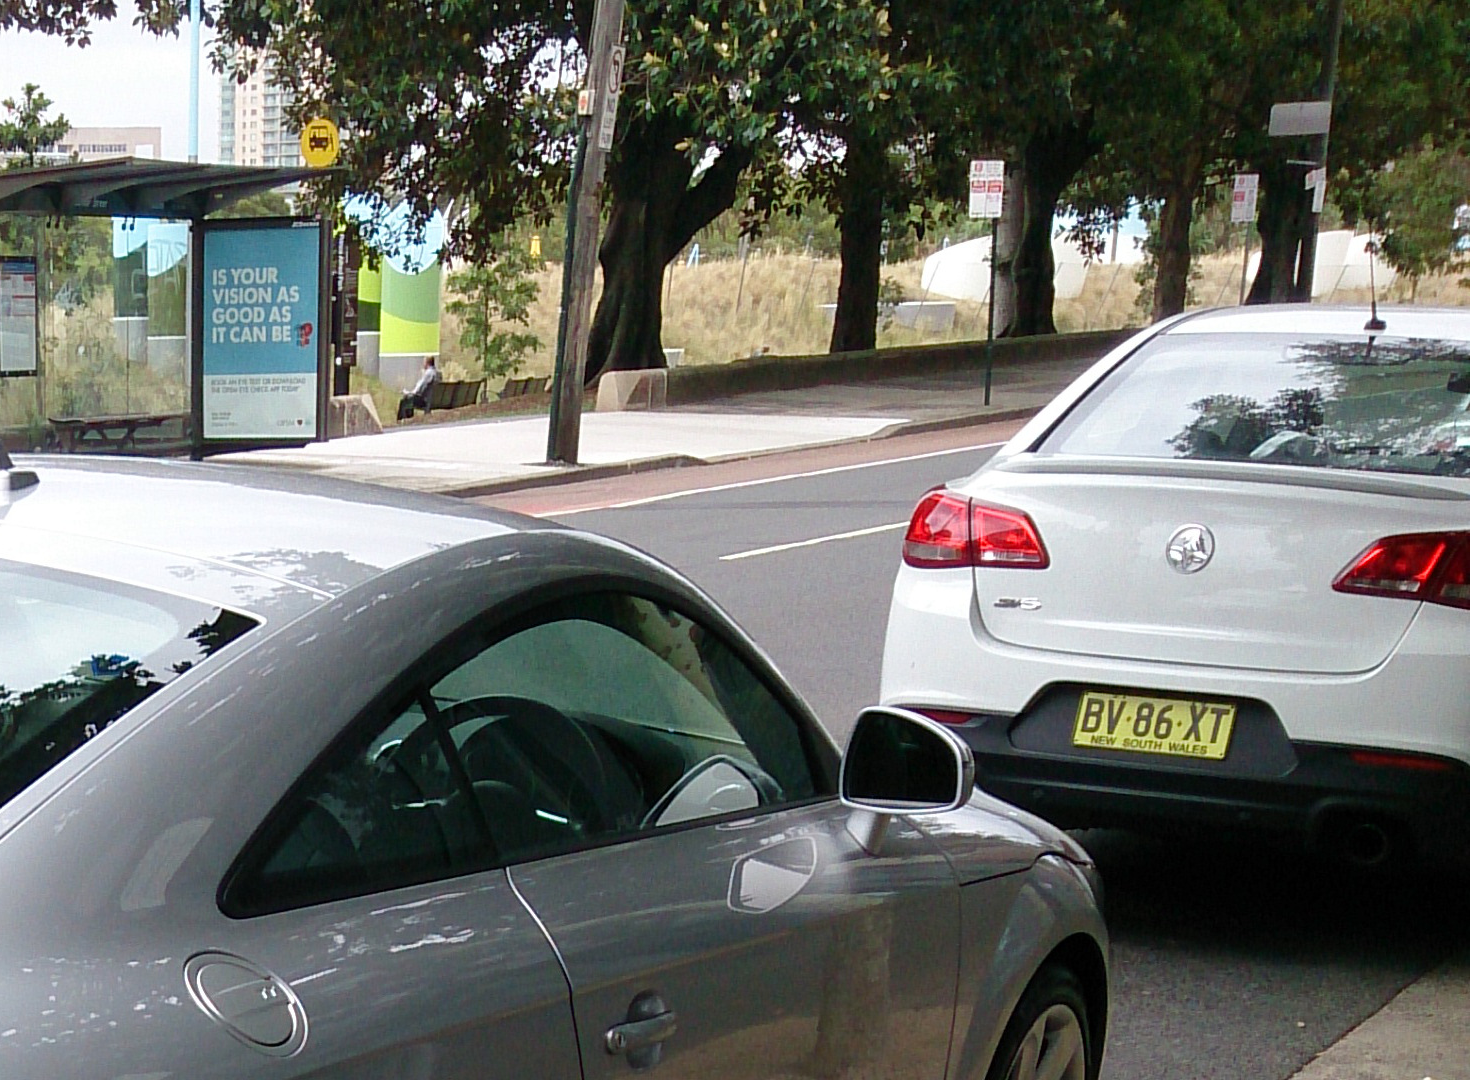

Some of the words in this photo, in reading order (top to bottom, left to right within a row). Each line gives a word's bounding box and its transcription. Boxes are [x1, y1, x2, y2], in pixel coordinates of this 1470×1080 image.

[212, 269, 227, 285] IS
[231, 267, 278, 284] YOUR
[212, 287, 272, 304] VISION
[276, 286, 300, 303] AS
[212, 307, 265, 324] GOOD
[269, 306, 291, 322] AS
[212, 327, 225, 343] IT
[230, 326, 266, 343] CAN
[272, 326, 291, 342] BE
[1090, 735, 1117, 746] NEW
[1122, 738, 1163, 750] SOUTH
[1169, 742, 1208, 755] WALES
